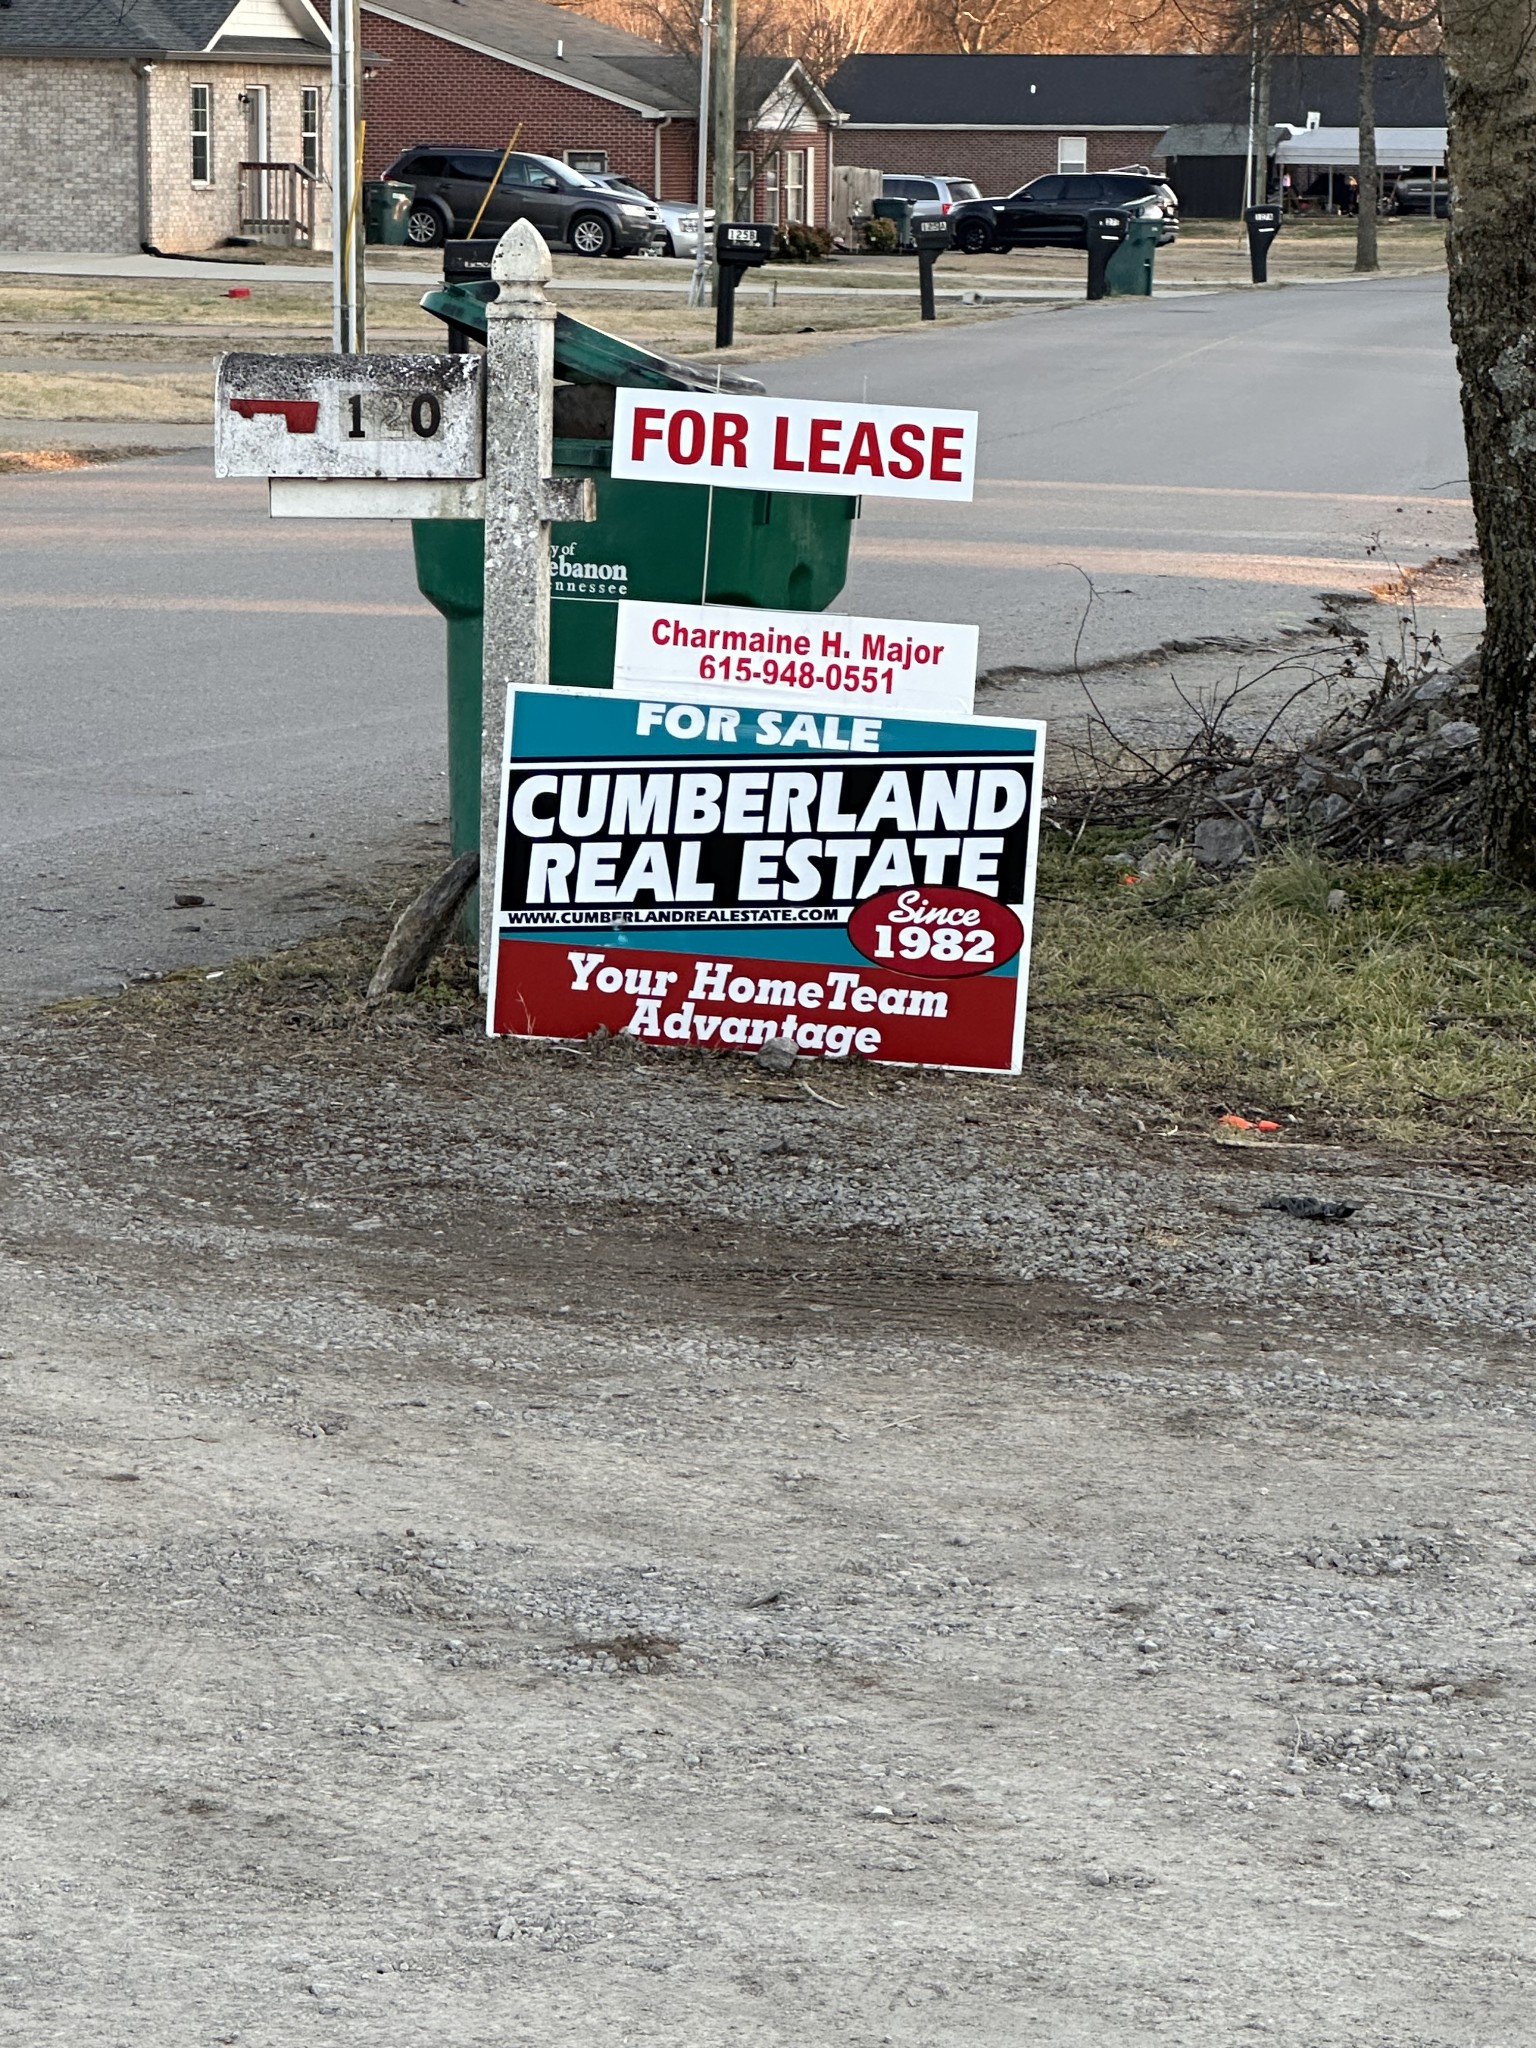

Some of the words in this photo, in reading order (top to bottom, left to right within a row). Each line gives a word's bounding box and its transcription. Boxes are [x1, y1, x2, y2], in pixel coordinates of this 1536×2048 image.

[729, 229, 757, 241] 125B
[631, 407, 749, 468] FOR
[773, 416, 964, 482] LEASE
[550, 555, 628, 581] ebanon
[561, 542, 578, 556] of
[550, 581, 628, 595] nnessee
[652, 619, 811, 656] Charmaine
[821, 631, 850, 659] H.
[862, 634, 945, 670] Major
[699, 654, 894, 695] 615-948-0551
[636, 702, 740, 743] FOR
[755, 711, 883, 753] SALE
[512, 769, 1027, 837] CUMBERLAND
[525, 841, 714, 904] REAL
[737, 838, 1004, 902] ESTATE
[508, 909, 839, 925] WWW.CUMBERLANDREALESTATE.COM
[888, 890, 981, 927] Since
[874, 925, 996, 963] 1982
[567, 951, 678, 998] Your
[627, 998, 882, 1058] Advantage
